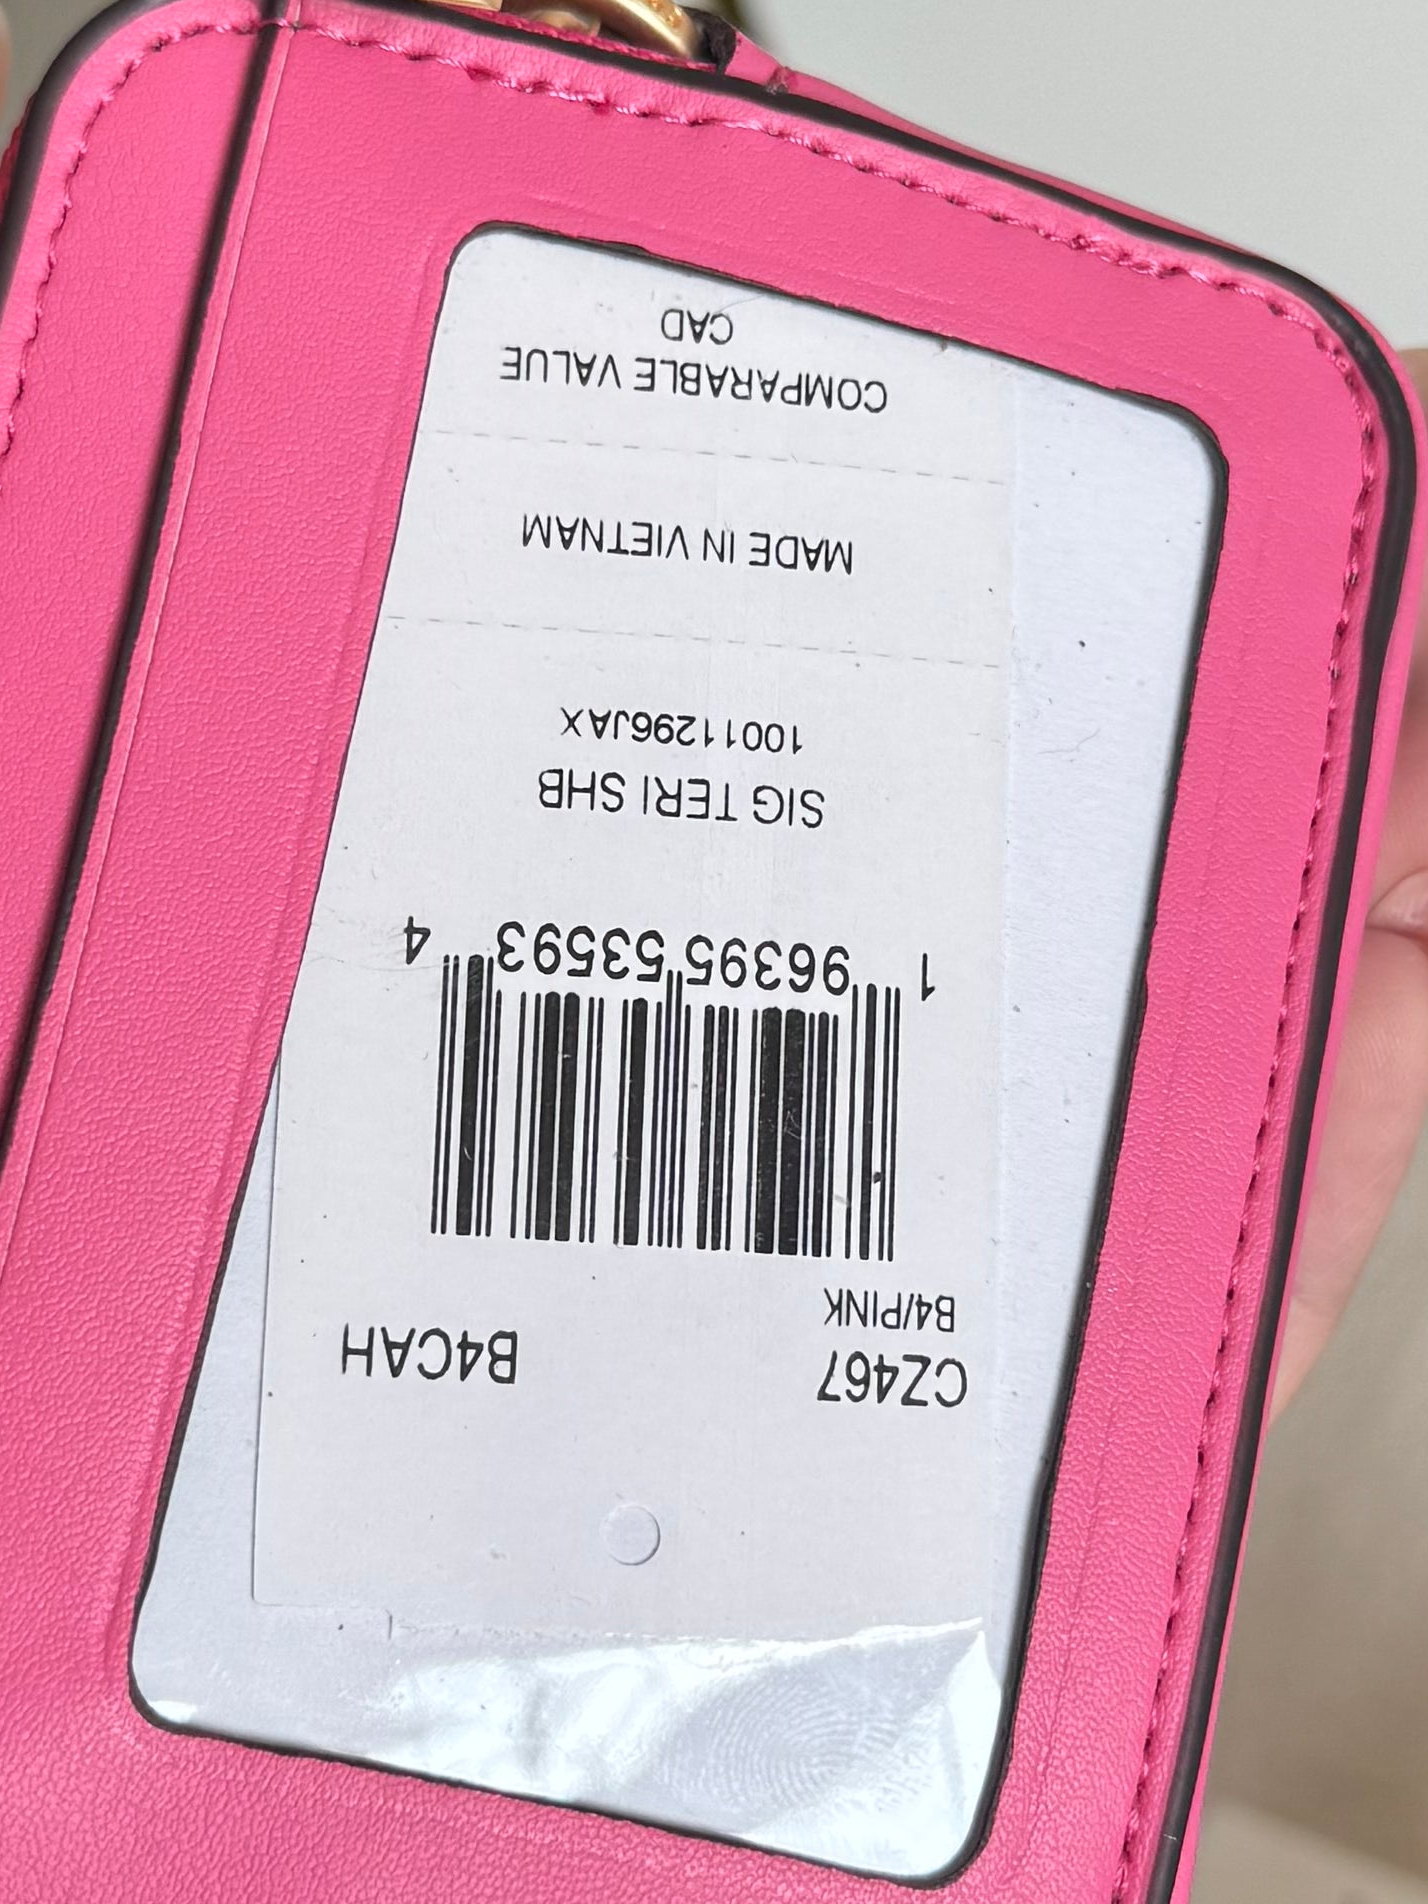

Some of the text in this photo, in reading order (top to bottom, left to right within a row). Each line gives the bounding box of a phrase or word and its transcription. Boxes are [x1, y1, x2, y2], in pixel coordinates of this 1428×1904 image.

[659, 307, 735, 346] CAD
[499, 345, 889, 415] COMPARABLE VALUE
[521, 513, 854, 576] MADE IN VIETNAM
[559, 706, 804, 756] 10011296JAX
[537, 767, 826, 830] SIG TERI SHB
[402, 914, 937, 1003] 1 96395 53593 4
[822, 1286, 956, 1334] B4/PINK
[340, 1322, 969, 1409] CZ467 B4CAH
